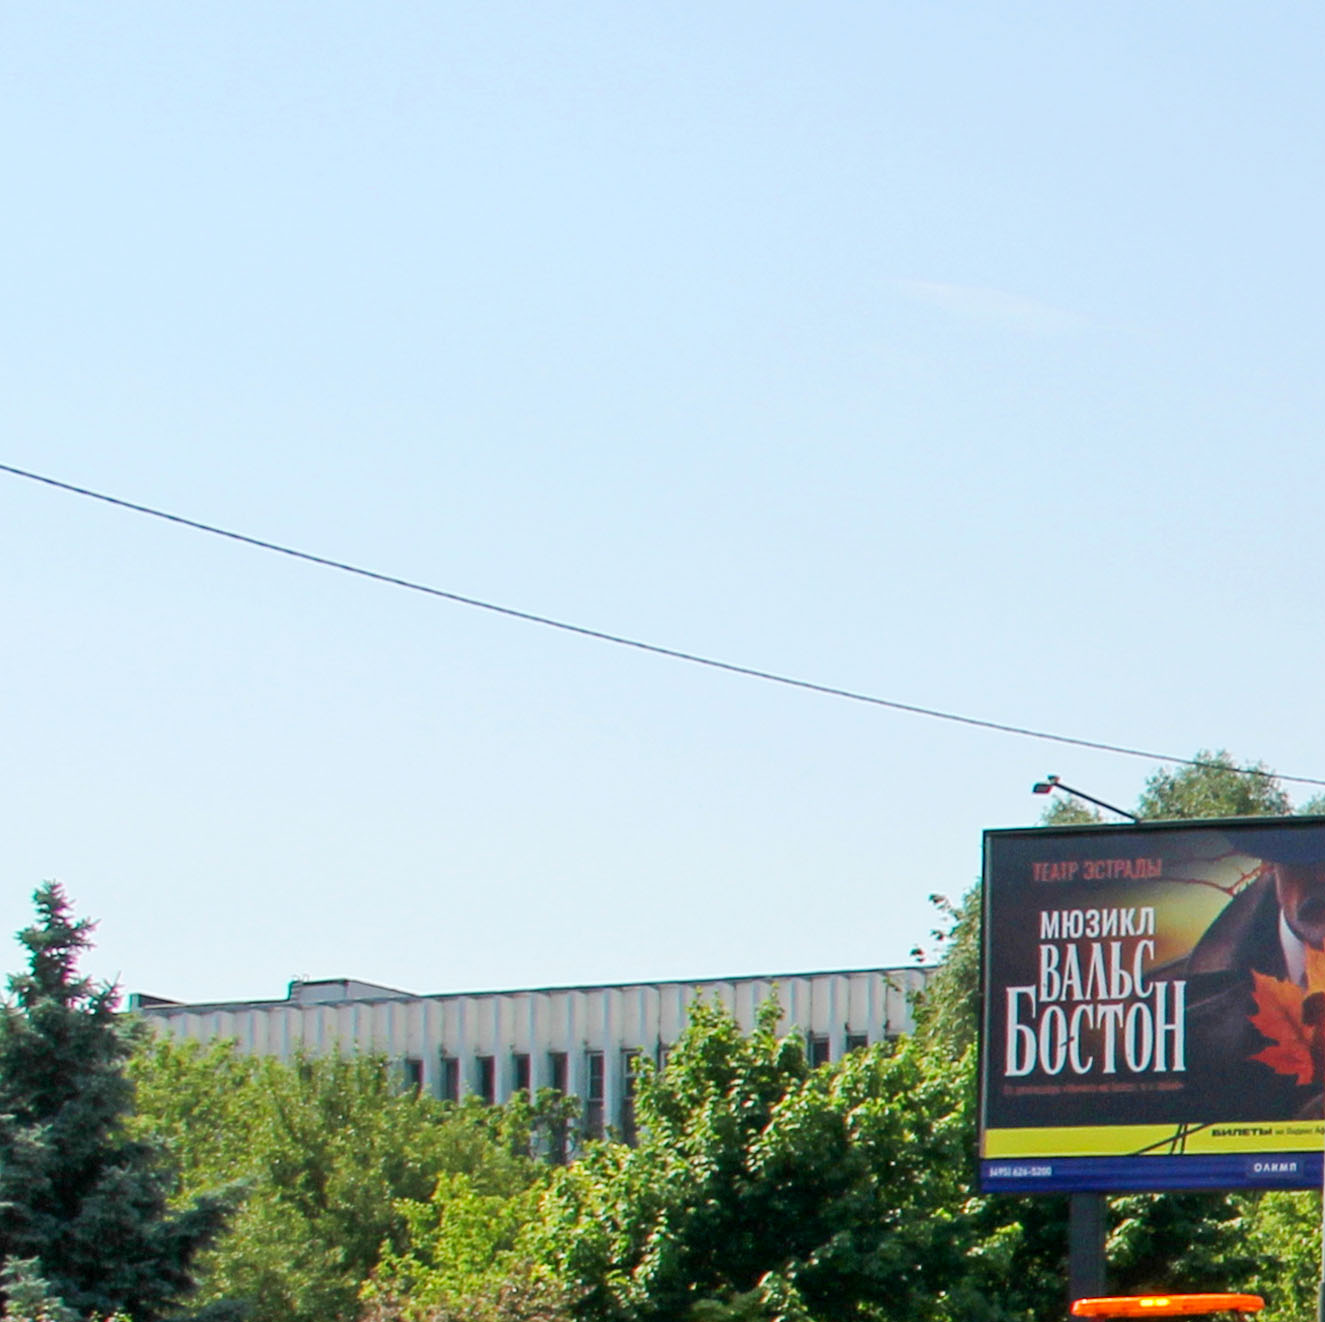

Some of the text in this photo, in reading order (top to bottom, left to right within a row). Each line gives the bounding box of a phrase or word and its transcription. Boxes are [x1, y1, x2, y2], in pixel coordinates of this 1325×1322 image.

[1032, 858, 1163, 882] ТЕАТР ЭСТРАДЫ
[1040, 906, 1155, 940] МЮЗИКЛ
[1039, 939, 1156, 1003] ВАЛЬС
[1004, 980, 1187, 1077] БОСТОН
[1212, 1127, 1272, 1137] БИЛЕТЫ
[1254, 1162, 1298, 1173] ОЛИМП
